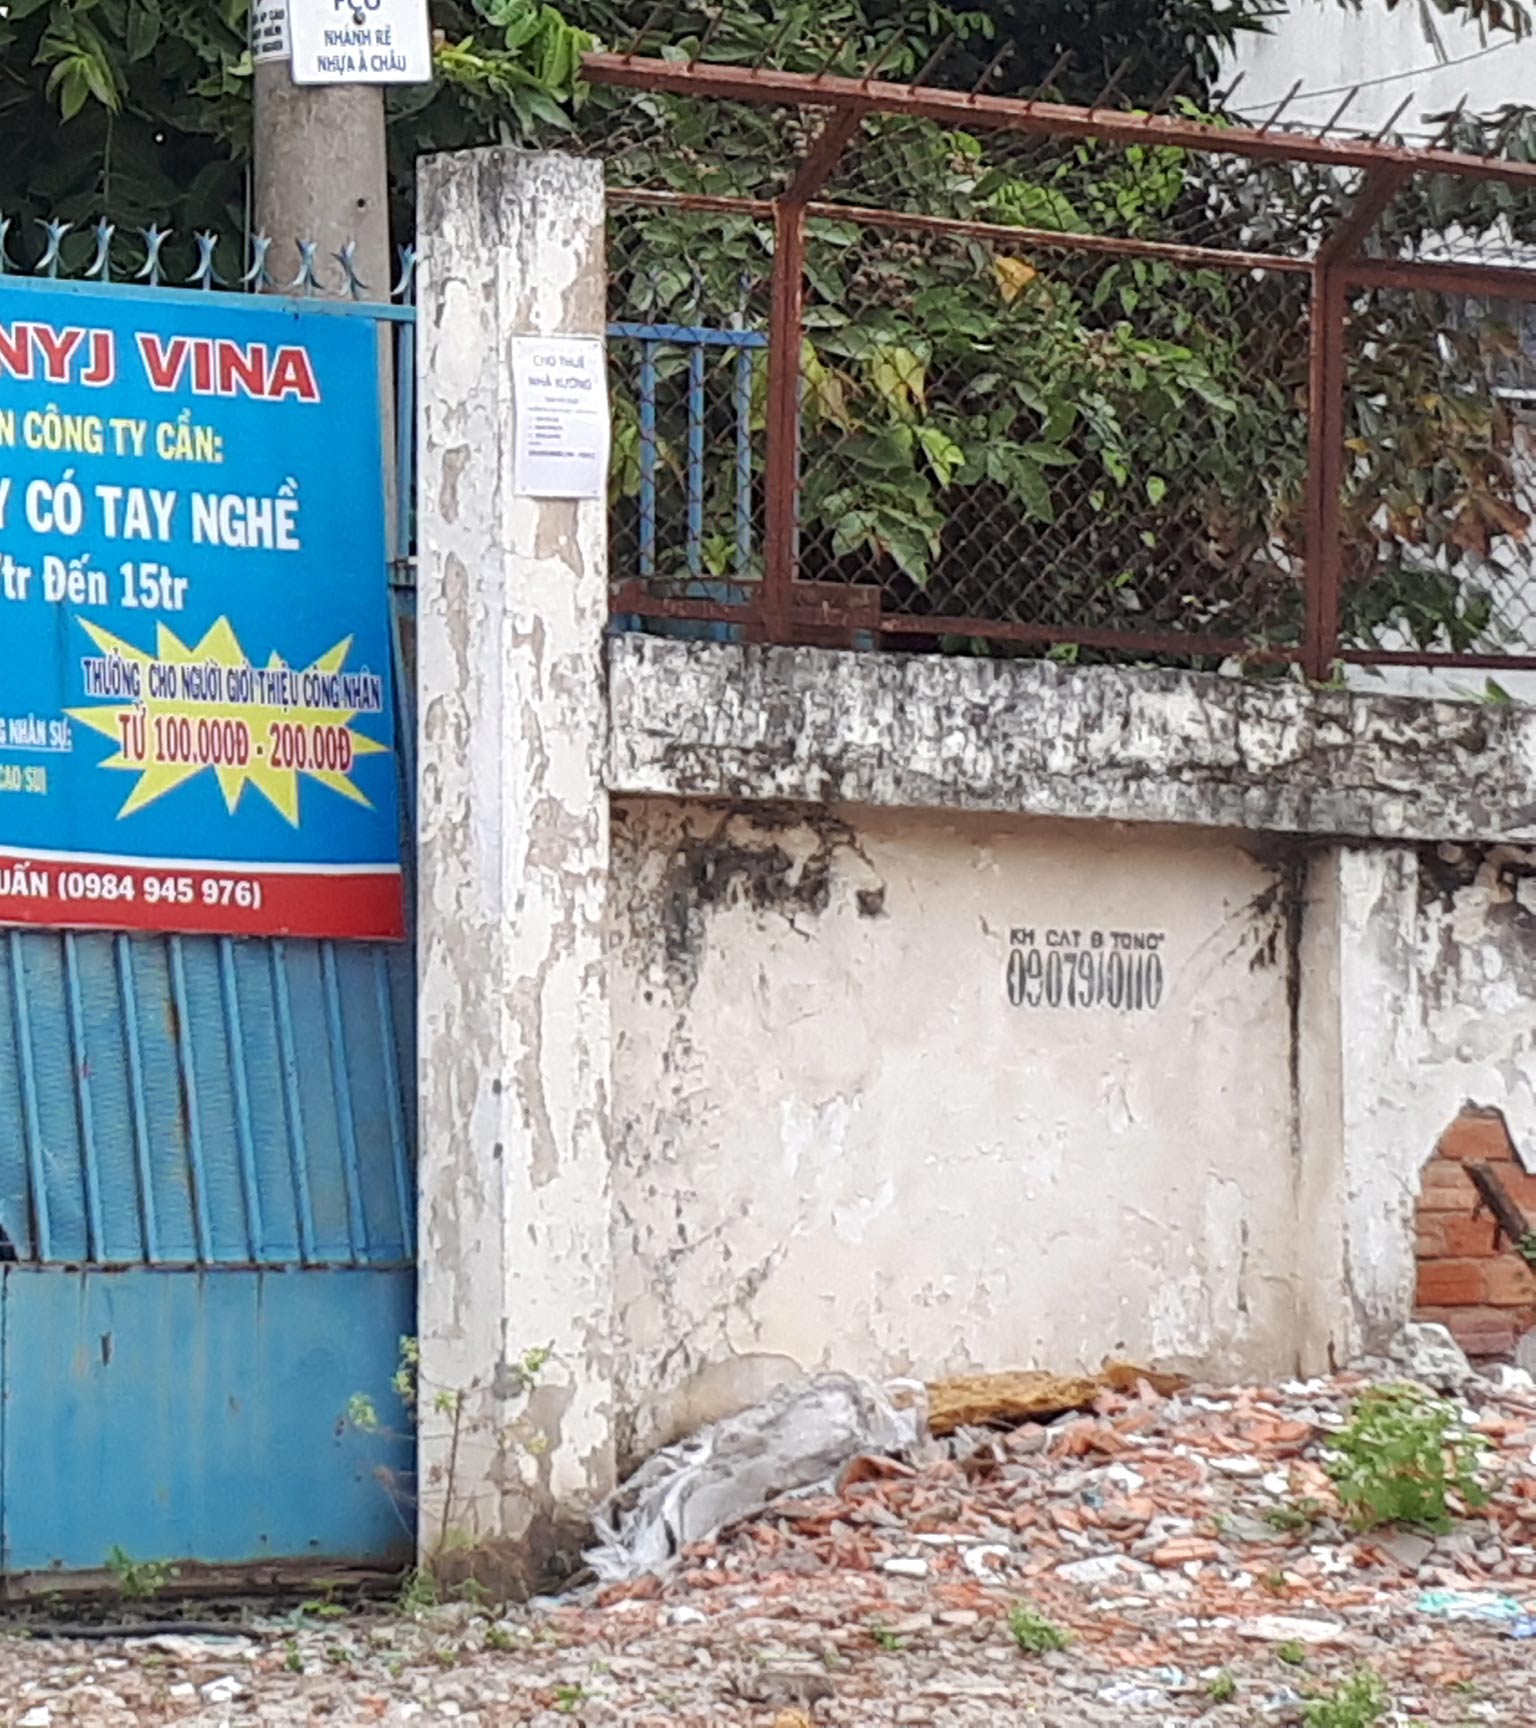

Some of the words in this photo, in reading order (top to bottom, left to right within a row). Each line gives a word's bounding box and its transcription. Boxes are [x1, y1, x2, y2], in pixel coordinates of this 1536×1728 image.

[135, 331, 321, 404] VINA
[24, 403, 102, 454] CÔNG
[109, 418, 146, 456] TY
[156, 408, 224, 464] CẦN:
[26, 468, 83, 536] CÓ
[95, 484, 178, 543] TAY
[191, 476, 301, 552] NGHỀ
[43, 552, 107, 606] Đến
[120, 561, 189, 612] 15tr
[83, 648, 142, 696] THƯỞNG
[148, 663, 177, 699] CHO
[180, 658, 223, 701] NGƯỜI
[227, 659, 254, 703] GIỚI
[258, 661, 300, 712] THIỆU
[302, 664, 340, 709] CÔNG
[342, 664, 382, 711] NHÂN
[155, 715, 250, 766] 100.000Đ
[269, 722, 353, 772] 200.00Đ
[58, 871, 136, 902] (0984
[143, 875, 194, 904] 945
[201, 878, 262, 911] 976)
[1009, 928, 1035, 946] KH
[1045, 929, 1081, 948] CAT
[1090, 930, 1104, 948] B
